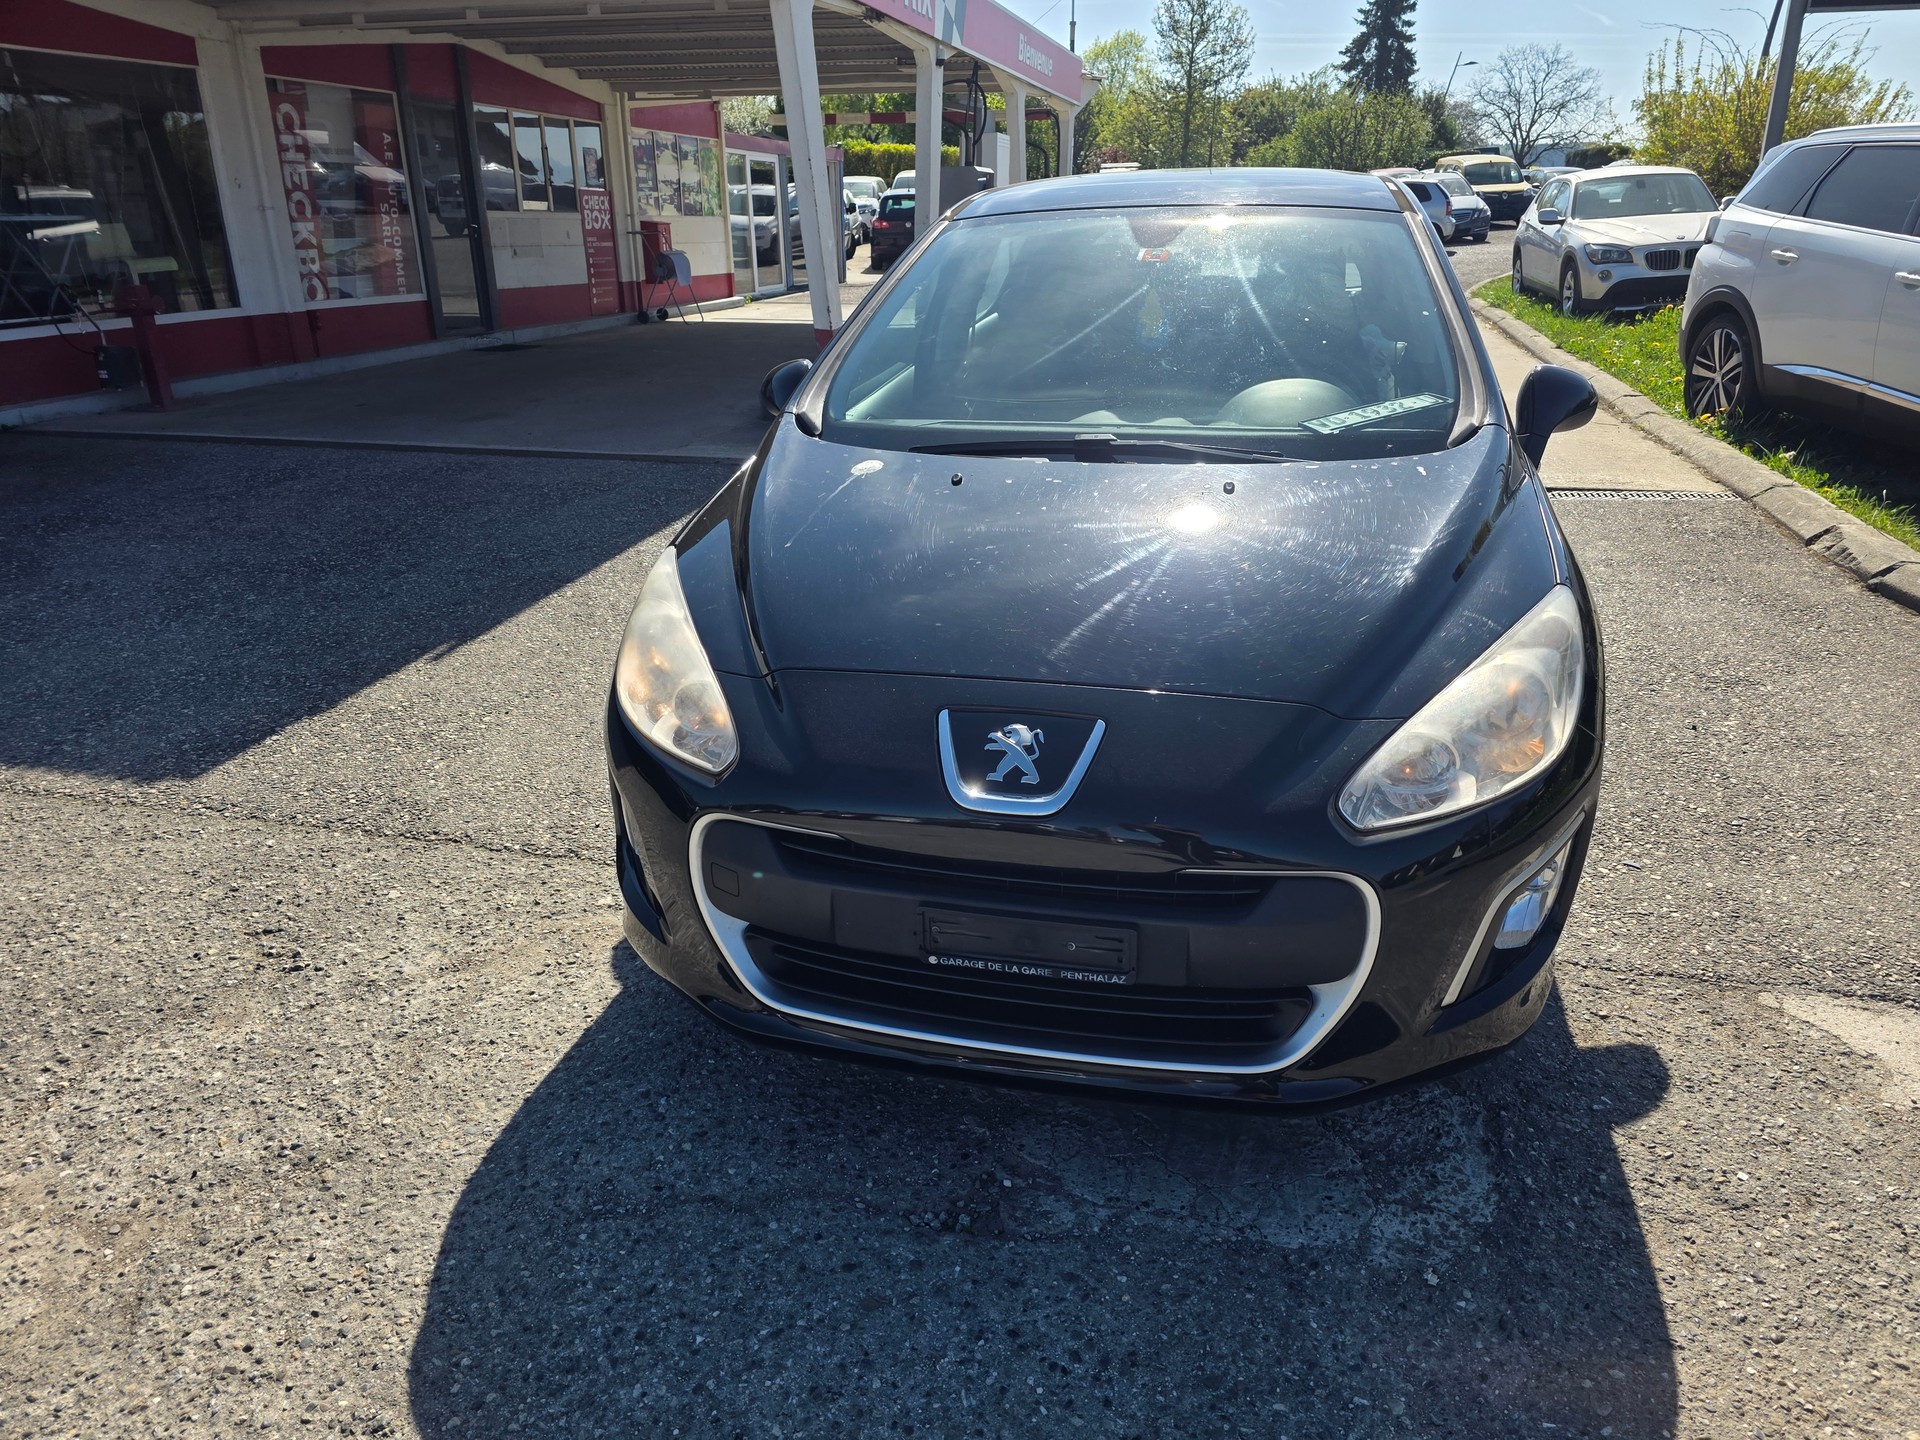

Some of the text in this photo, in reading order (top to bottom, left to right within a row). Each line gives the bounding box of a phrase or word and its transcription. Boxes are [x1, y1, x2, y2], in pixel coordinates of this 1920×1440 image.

[1018, 34, 1053, 76] Bienvenue
[382, 132, 406, 295] A.E. UTO-COMMER
[582, 195, 610, 210] CHECK
[379, 203, 393, 247] SARL
[584, 210, 611, 230] BOX
[940, 957, 1127, 984] GARAGE DE LA GARE PENTHALAZ
